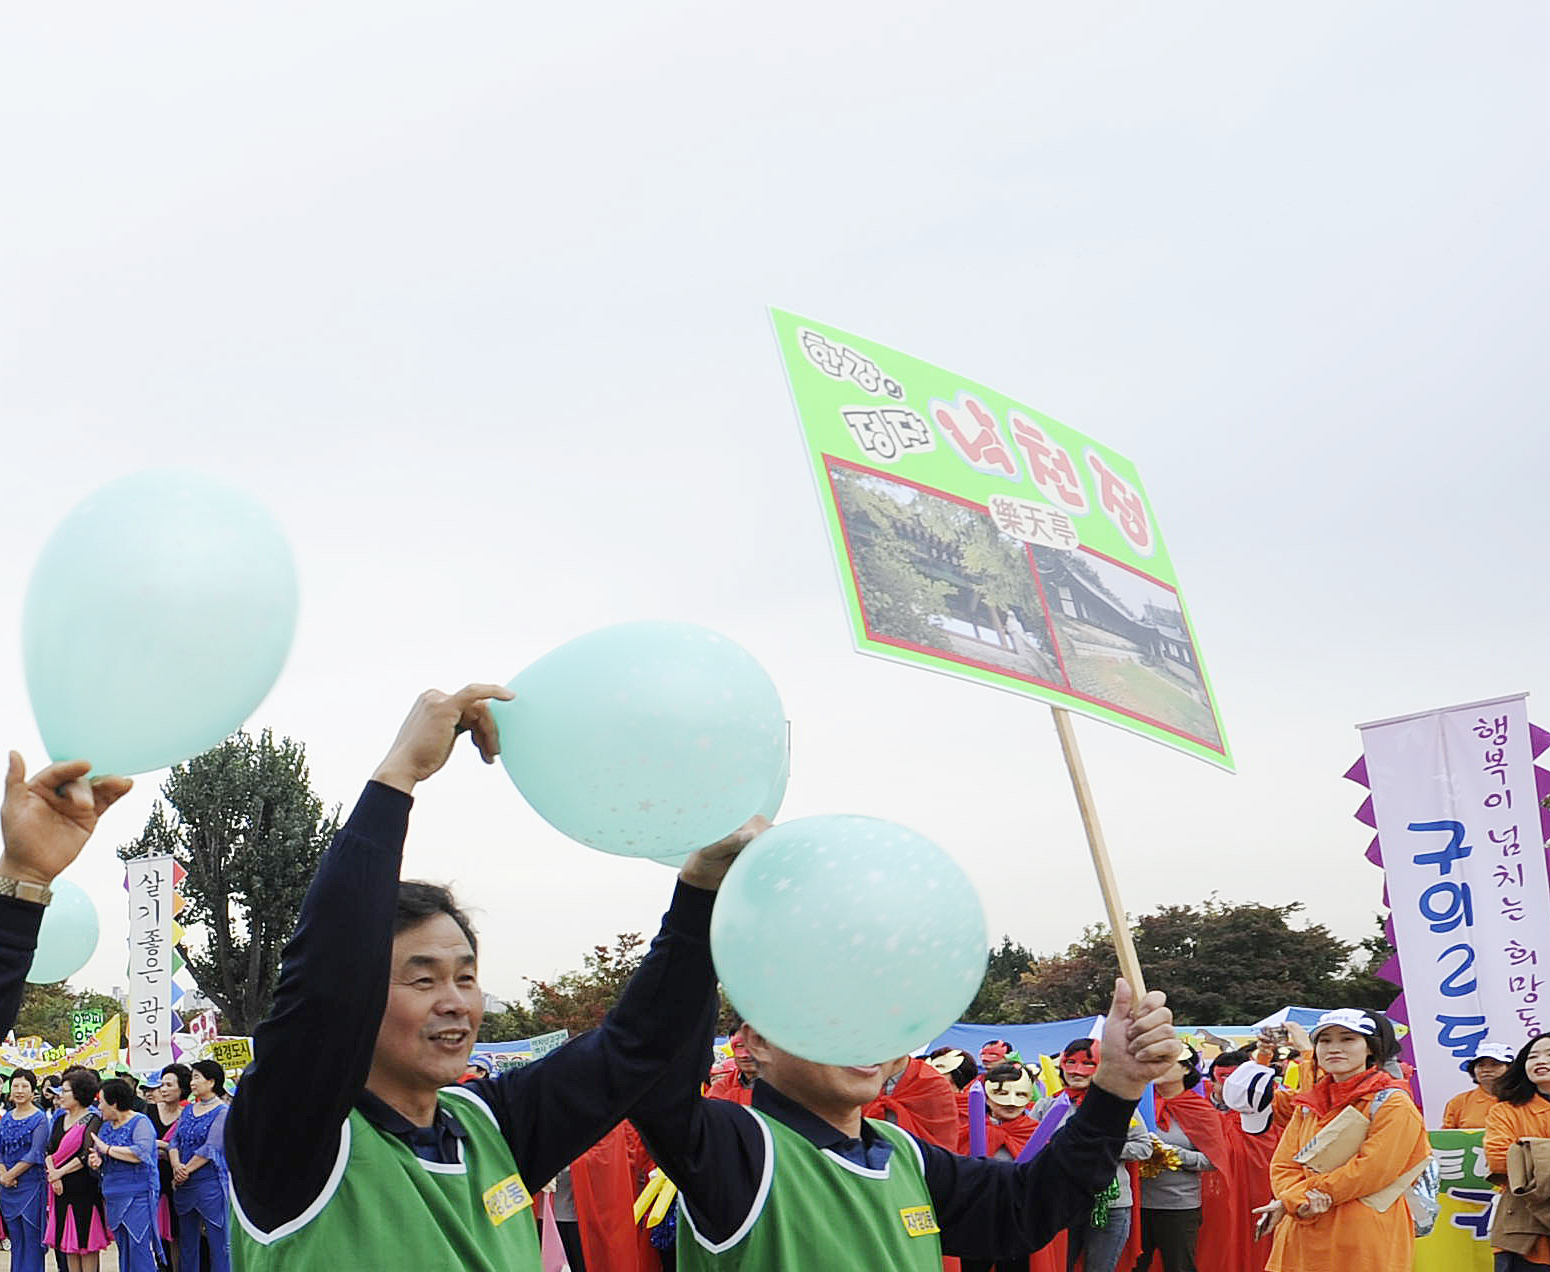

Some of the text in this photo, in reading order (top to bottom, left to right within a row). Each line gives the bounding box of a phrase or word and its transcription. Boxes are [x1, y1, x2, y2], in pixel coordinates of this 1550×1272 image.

[843, 409, 930, 459] 정자
[936, 399, 1149, 548] 낙천정
[992, 498, 1077, 546] 樂天亭
[1472, 715, 1512, 810] 행복이
[1487, 825, 1526, 922] 넘치는
[136, 996, 165, 1057] 광진
